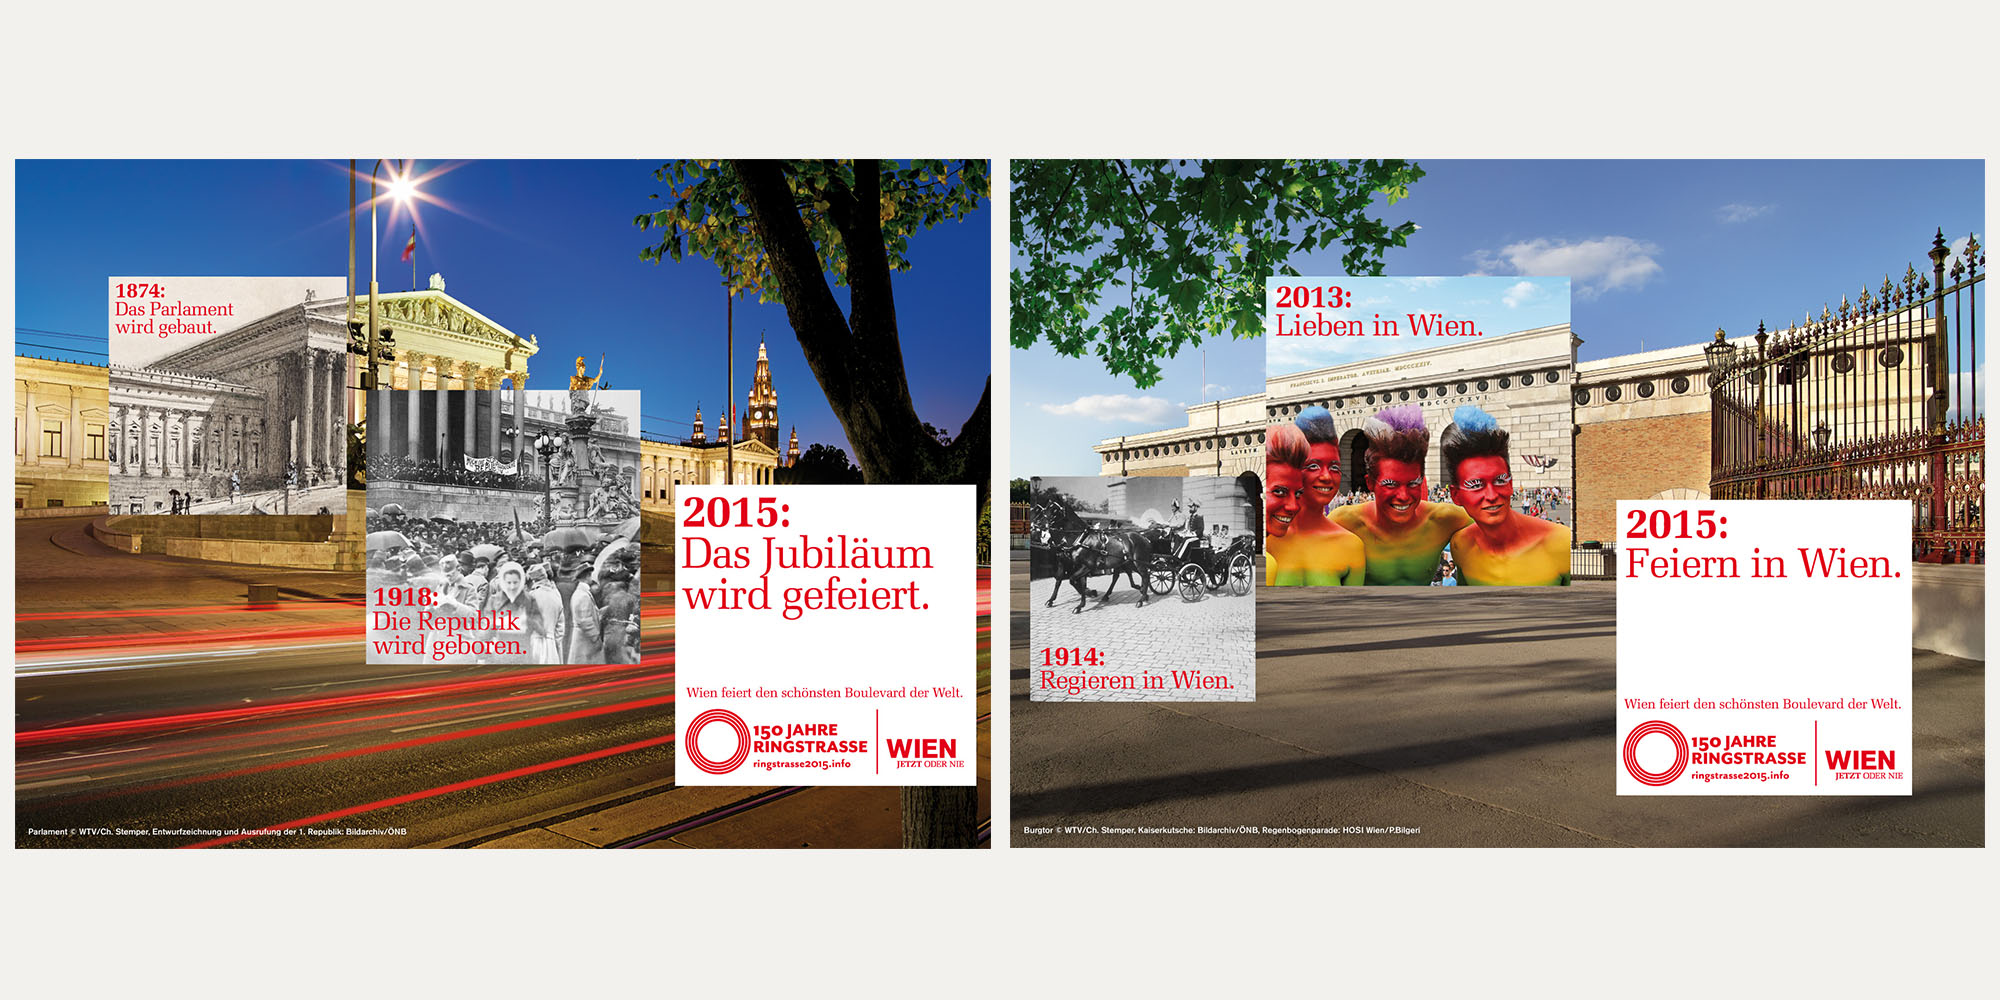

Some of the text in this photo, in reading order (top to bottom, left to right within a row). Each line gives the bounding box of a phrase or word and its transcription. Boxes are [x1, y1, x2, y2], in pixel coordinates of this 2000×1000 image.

[115, 282, 166, 299] 1874:
[1275, 285, 1352, 309] 2013:
[114, 300, 233, 317] Das Parlament
[115, 318, 217, 339] wird gebaut.
[1275, 311, 1483, 337] Lieben in Wien.
[683, 496, 790, 528] 2015:
[1626, 509, 1728, 540] 2015:
[681, 535, 934, 578] Das Jubiläum
[1625, 547, 1901, 579] Feiern in Wien.
[373, 586, 439, 607] 1918:
[682, 575, 930, 621] wird gefeiert.
[372, 609, 521, 637] Die Republik
[372, 633, 527, 662] wird geboren.
[1040, 647, 1105, 667] 1914:
[686, 686, 963, 699] Wien feiert den schönsten Boulevard der Welt.
[1039, 669, 1235, 696] Regieren in Wien.
[1624, 697, 1902, 710] Wien feiert den schönsten Boulevard der Welt.
[753, 723, 838, 740] 150 JAHRE
[753, 740, 868, 754] RINGSTRASSE
[885, 738, 957, 759] WIEN
[1691, 734, 1777, 751] 150 JAHRE
[753, 758, 851, 772] ringstrasse2015.info
[896, 760, 965, 769] JETZT ODER NIE
[1691, 751, 1807, 765] RINGSTRASSE
[1824, 749, 1896, 770] WIEN
[1691, 769, 1790, 784] ringstrasse2015.info
[1835, 771, 1904, 781] JETZT ODER NIE
